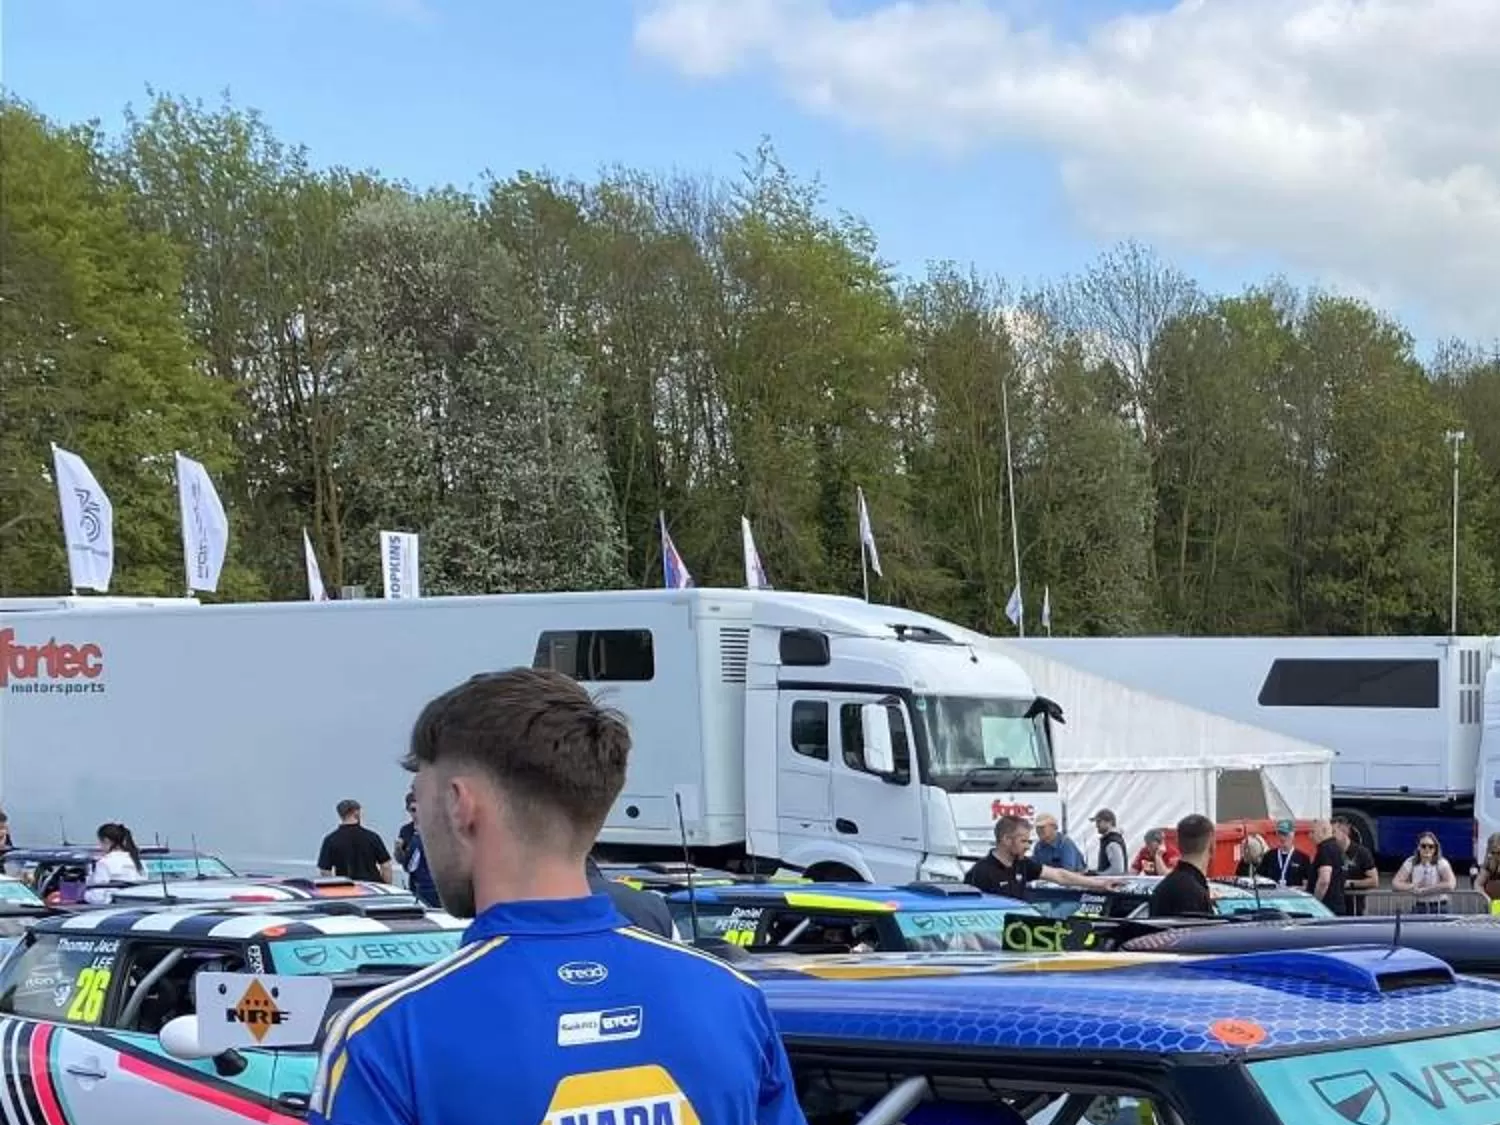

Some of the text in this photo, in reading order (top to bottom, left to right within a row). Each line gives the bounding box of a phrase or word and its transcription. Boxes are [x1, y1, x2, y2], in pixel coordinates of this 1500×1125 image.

[0, 628, 103, 687] fortec
[11, 683, 105, 696] motorsports
[58, 938, 93, 951] Thomas
[91, 956, 113, 969] LEE
[66, 968, 111, 1022] 26
[226, 1008, 292, 1025] NRF
